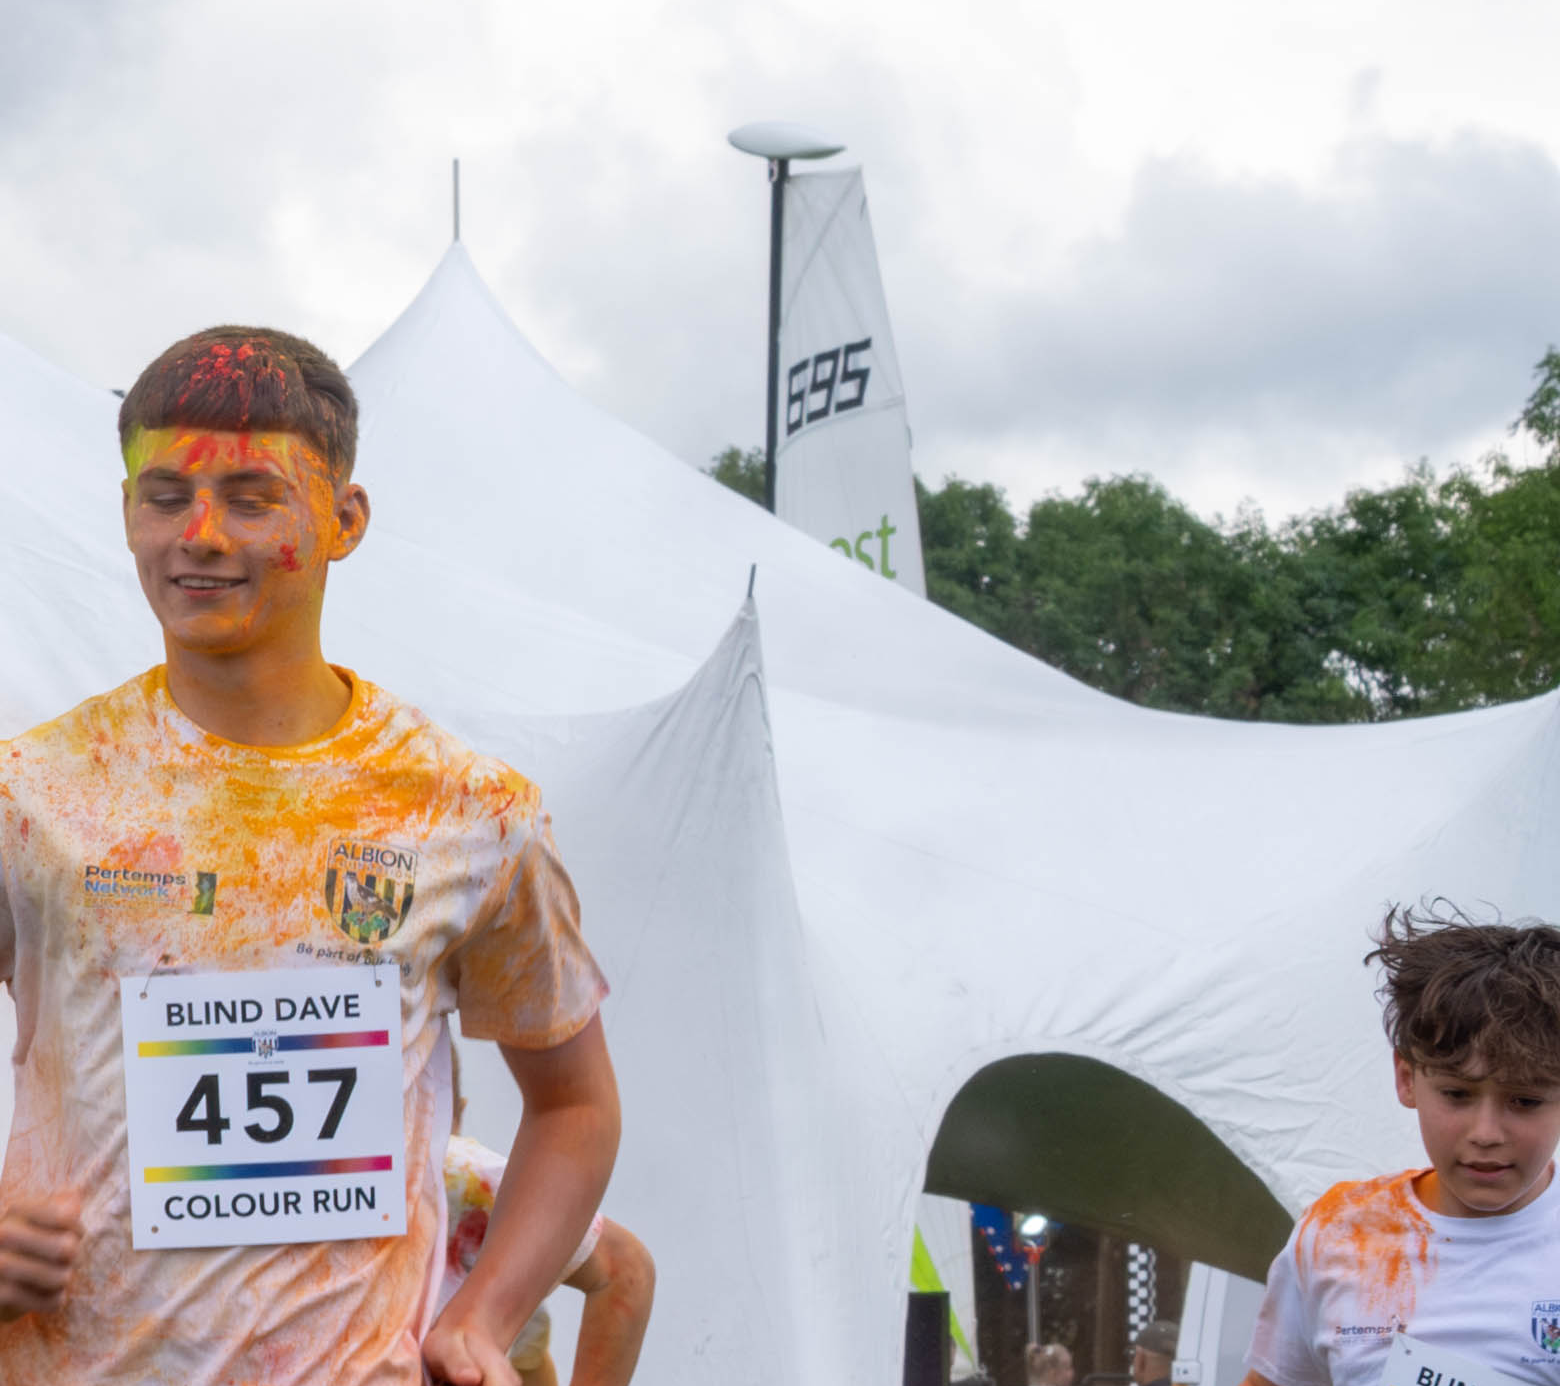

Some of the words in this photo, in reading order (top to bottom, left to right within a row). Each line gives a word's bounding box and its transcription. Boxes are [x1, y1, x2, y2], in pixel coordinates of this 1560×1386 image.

[787, 337, 872, 437] 695
[334, 844, 414, 872] ALBION
[85, 865, 187, 886] Pertemps
[166, 999, 264, 1027] BLIND
[275, 993, 361, 1022] DAVE
[176, 1066, 358, 1145] 457
[164, 1191, 302, 1221] COLOUR
[313, 1186, 376, 1214] RUN
